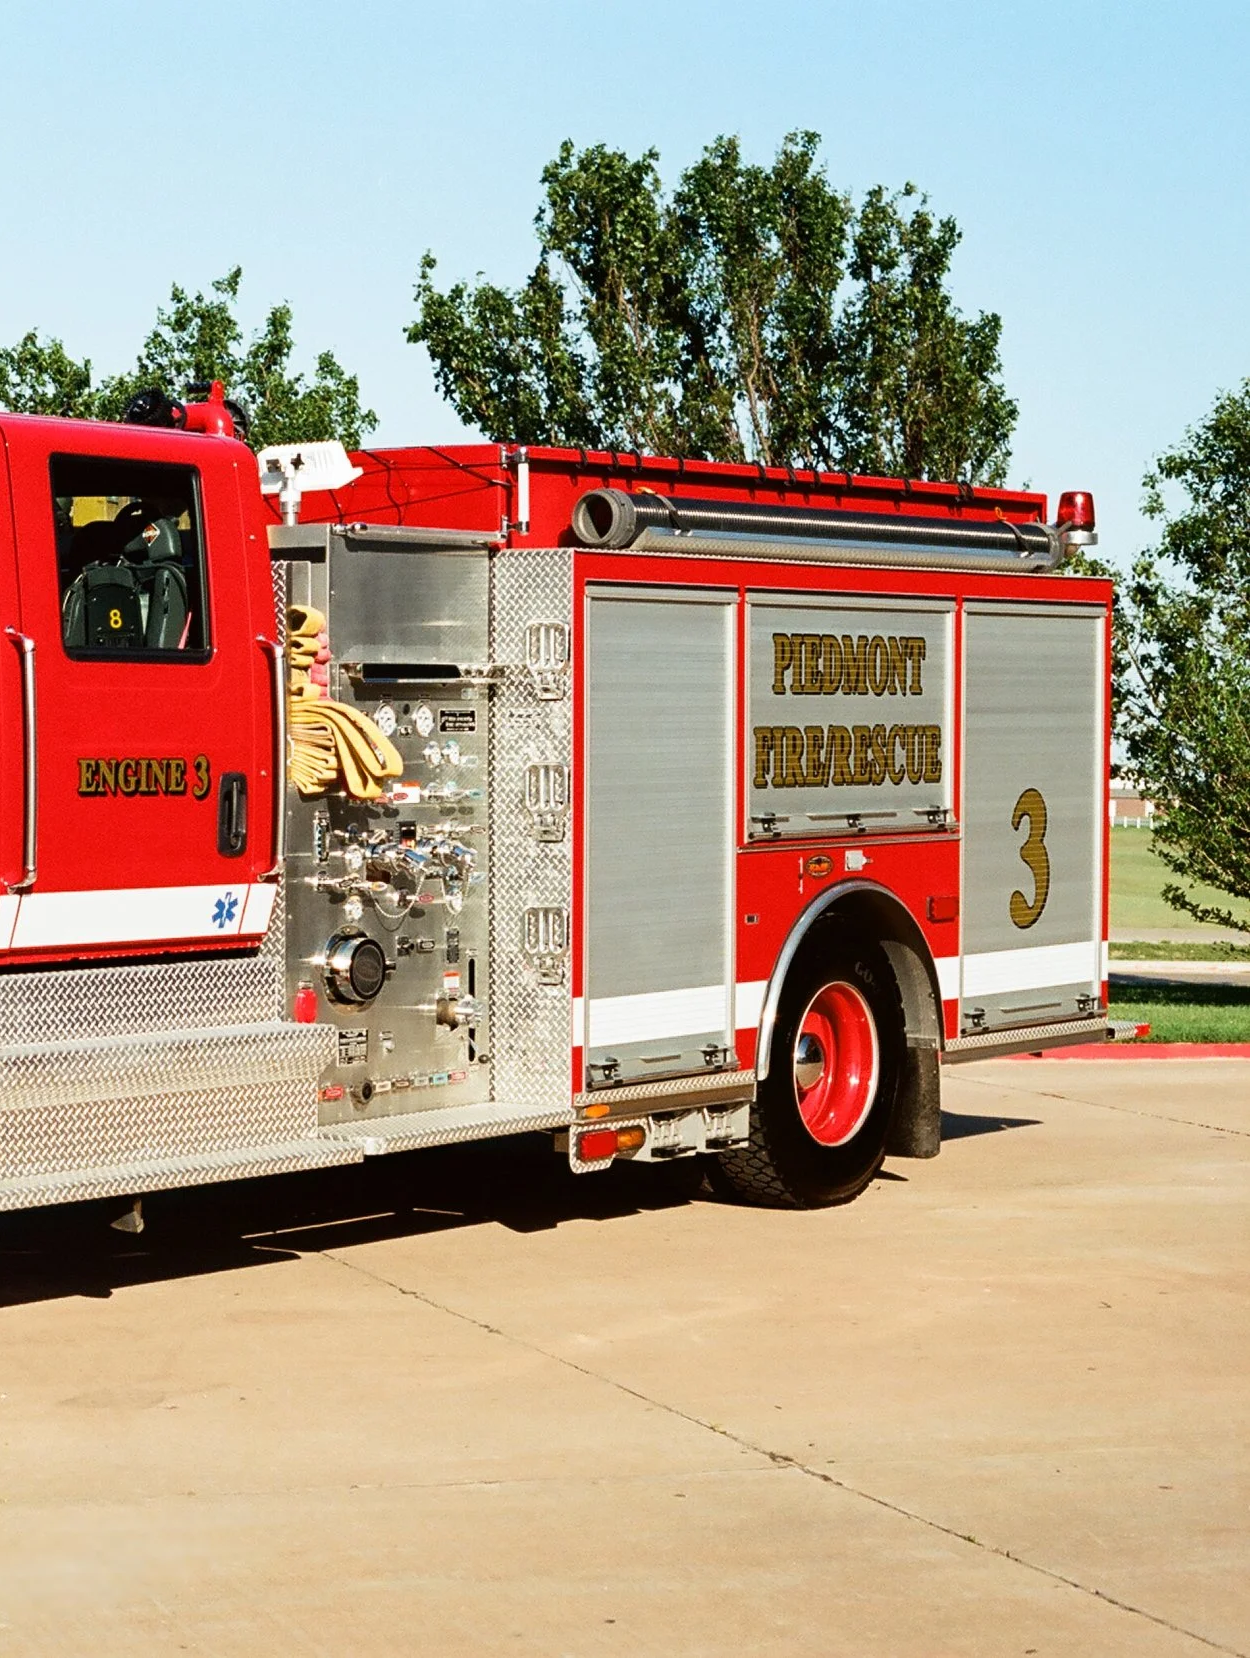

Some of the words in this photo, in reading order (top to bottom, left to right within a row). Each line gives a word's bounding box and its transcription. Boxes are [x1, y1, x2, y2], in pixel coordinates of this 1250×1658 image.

[109, 609, 123, 629] 8
[772, 633, 926, 696] PIEDMONT
[77, 758, 188, 797] ENGINE
[193, 754, 210, 799] 3
[753, 723, 943, 788] FIRE/RESCUE
[1010, 787, 1050, 929] 3
